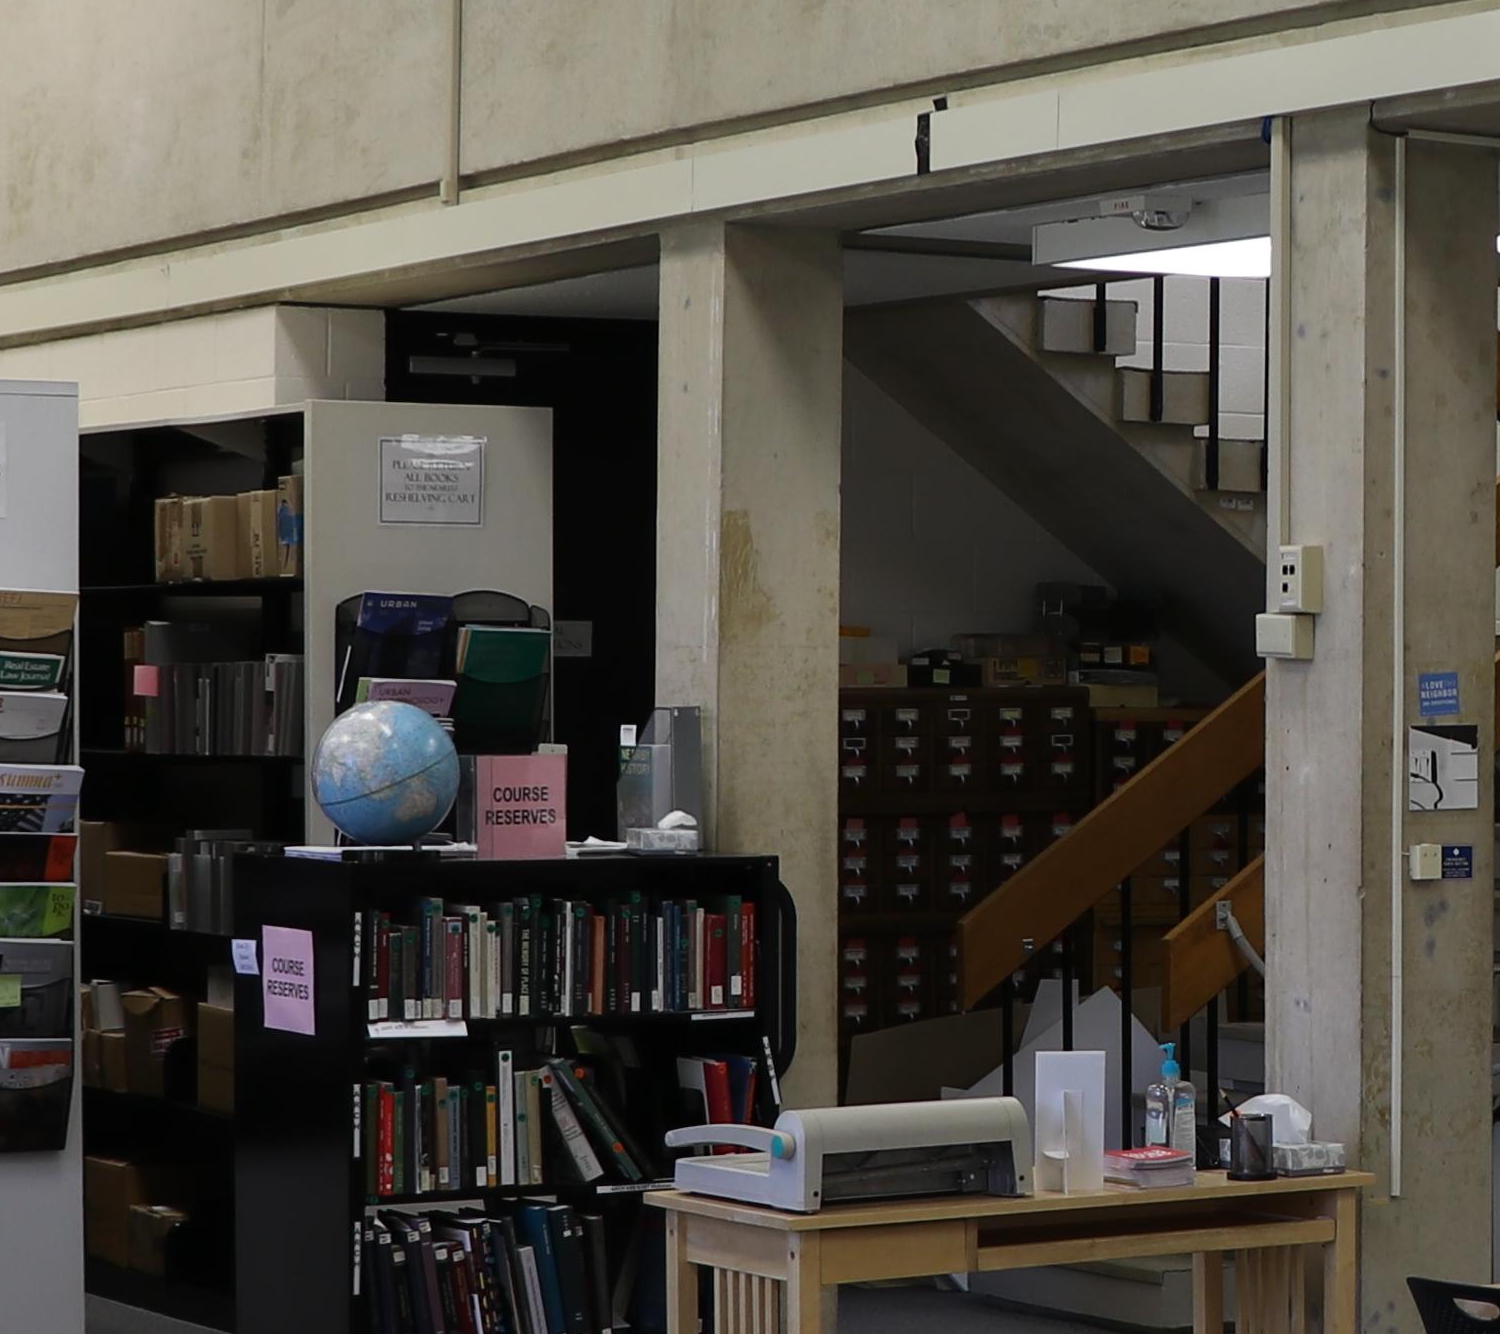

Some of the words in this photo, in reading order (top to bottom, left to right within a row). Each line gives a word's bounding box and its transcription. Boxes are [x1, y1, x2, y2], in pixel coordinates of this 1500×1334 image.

[424, 473, 460, 483] BOOKS
[385, 492, 447, 504] RESHELVING
[448, 493, 477, 504] CART
[380, 600, 418, 609] URBAN
[4, 660, 23, 671] Real
[25, 661, 51, 672] Estate
[0, 670, 18, 680] Law
[19, 671, 52, 682] Journal
[493, 786, 549, 802] COURSE
[485, 809, 556, 826] RESERVES
[272, 957, 304, 976] COURSE
[267, 979, 309, 1000] RESERVES
